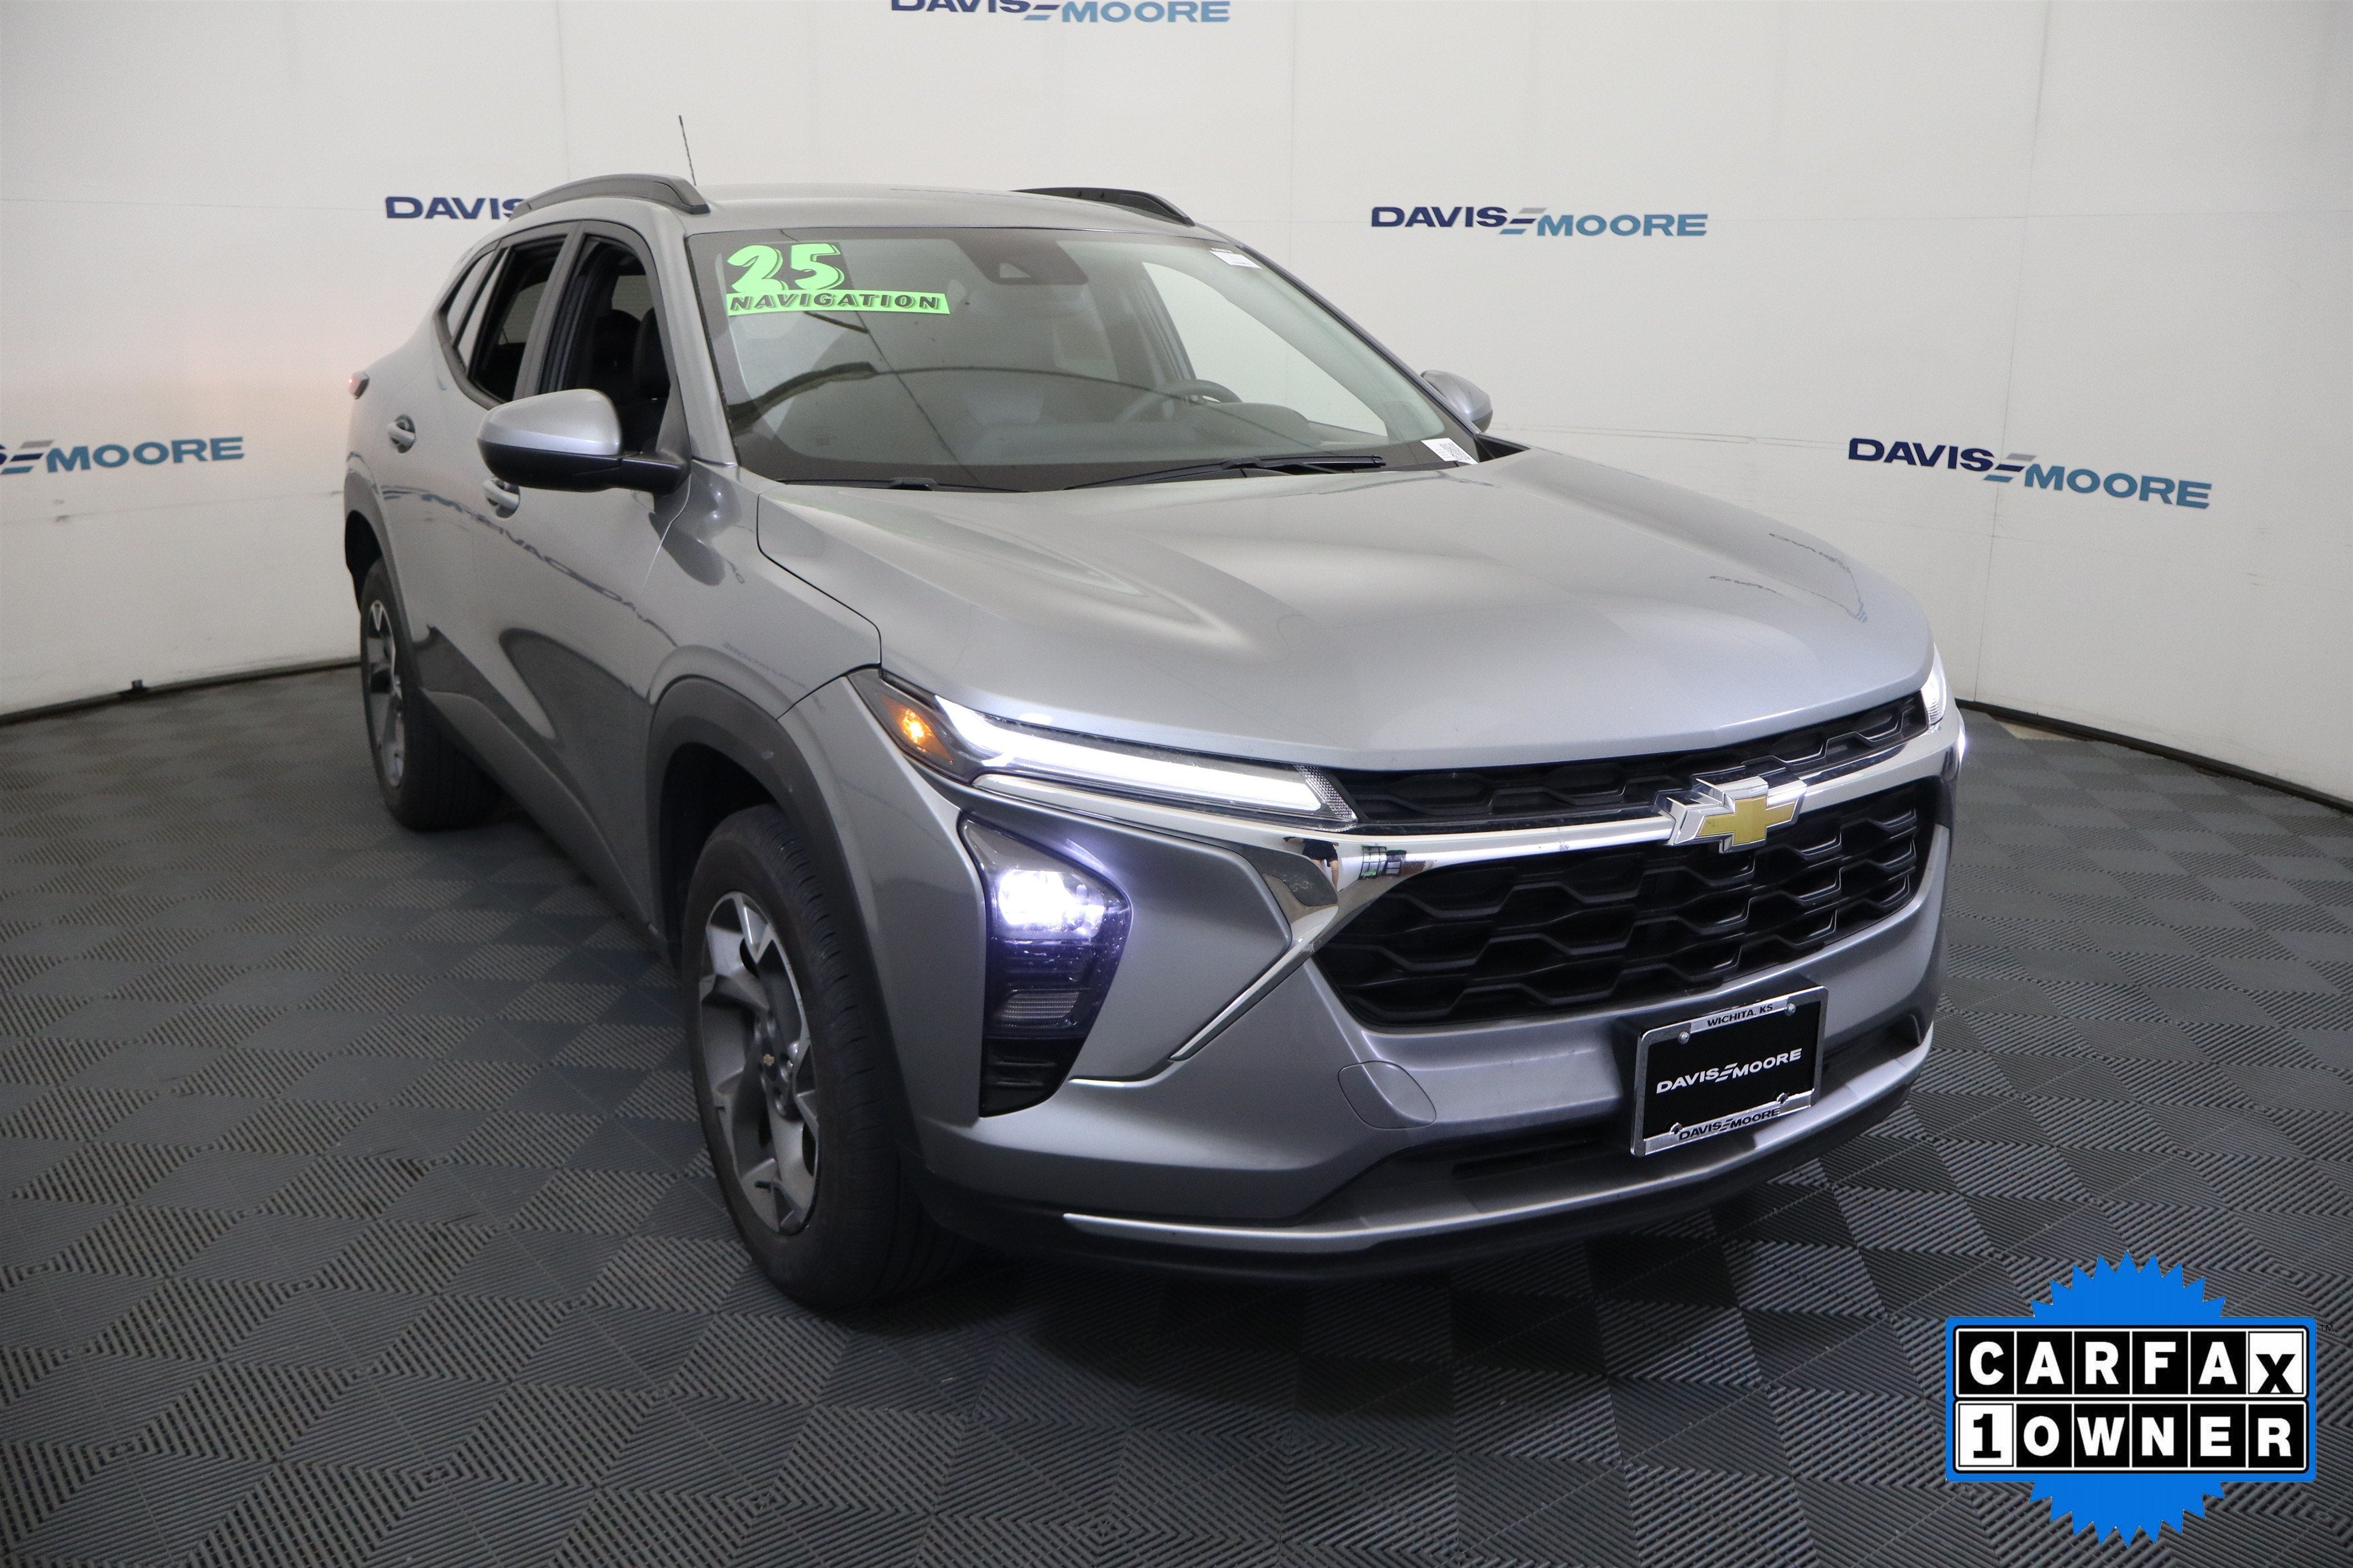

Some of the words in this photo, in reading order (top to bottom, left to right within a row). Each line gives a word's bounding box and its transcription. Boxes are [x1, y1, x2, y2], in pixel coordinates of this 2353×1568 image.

[1062, 1, 1230, 22] MOORE
[1371, 206, 1508, 228] DAVIS
[1536, 214, 1708, 237] MOORE
[727, 242, 844, 291] 25
[730, 292, 939, 311] NAVIGATION
[46, 437, 245, 473] MOORE
[1848, 437, 1995, 472] DAVIS
[2024, 463, 2212, 509] MOORE
[1760, 1004, 1773, 1014] KS
[1656, 1067, 1720, 1094] DAVIS
[1732, 1048, 1802, 1079] MOORE
[1679, 1122, 1722, 1141] DAVIS
[1730, 1107, 1781, 1129] MOORE
